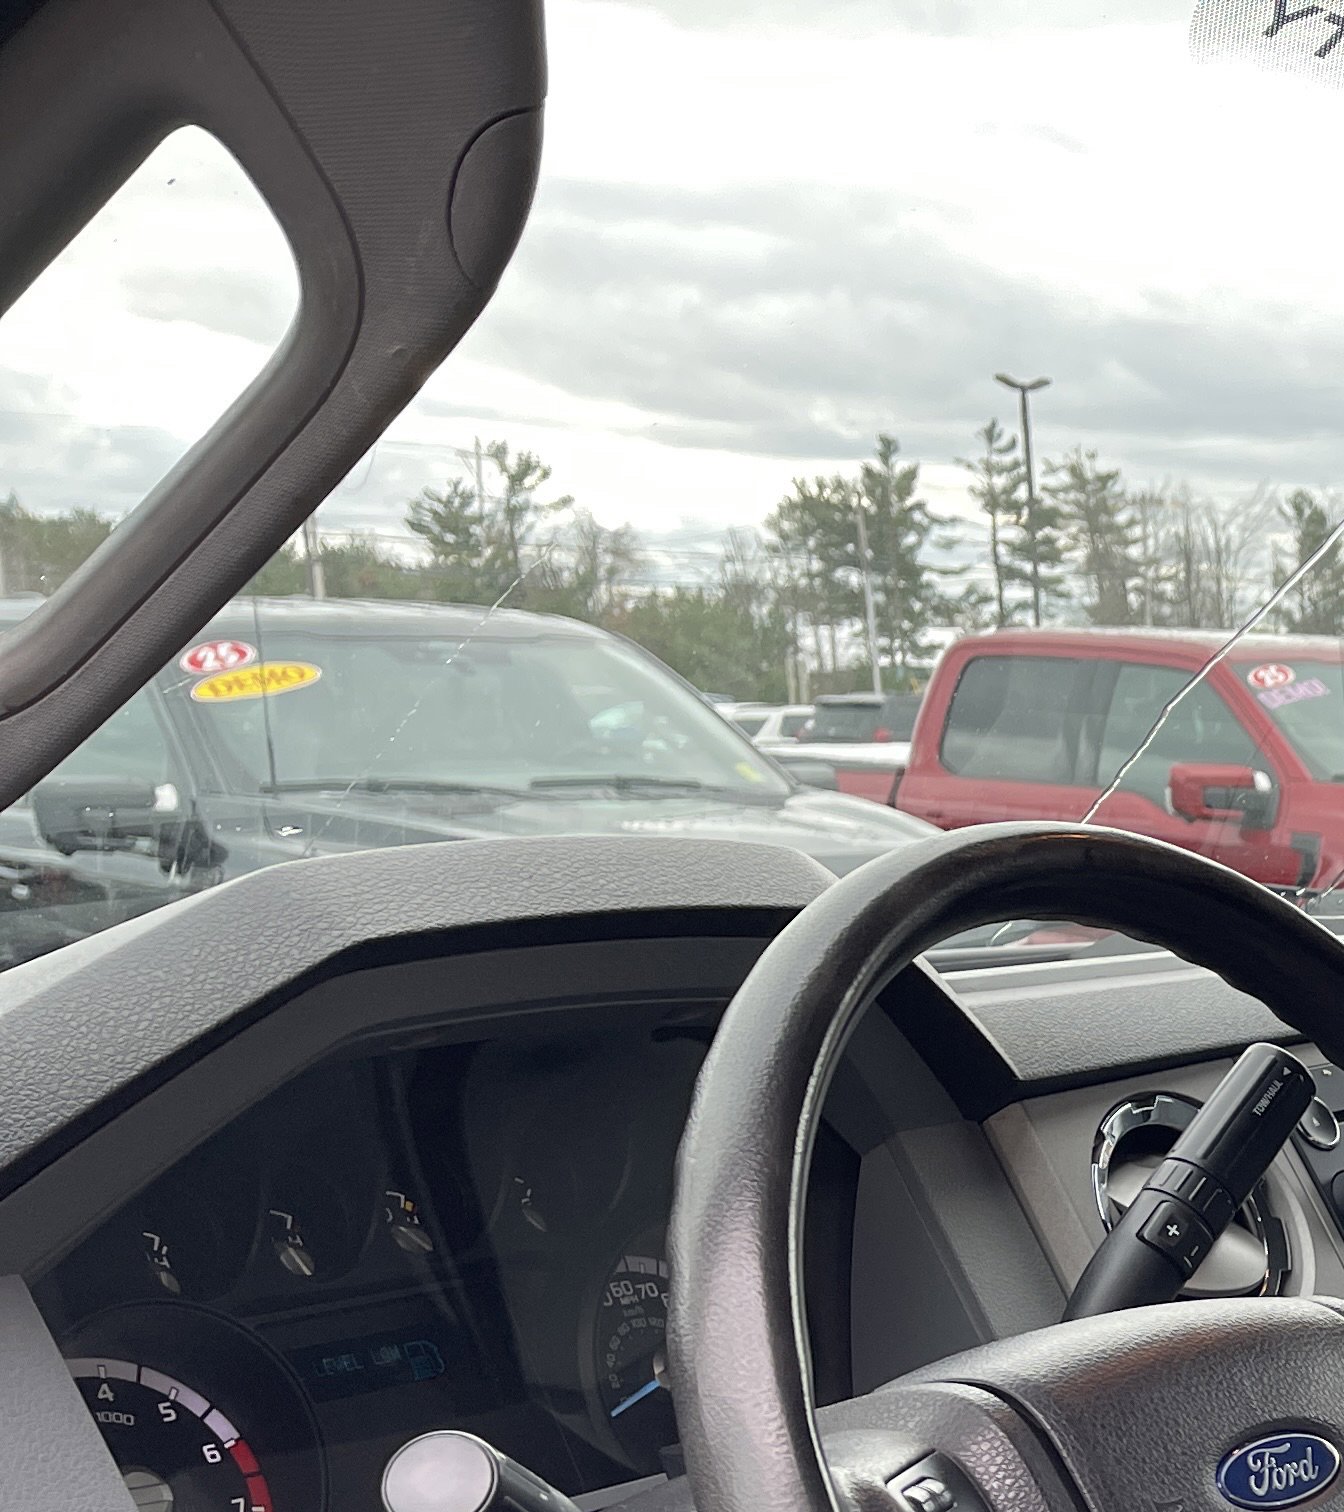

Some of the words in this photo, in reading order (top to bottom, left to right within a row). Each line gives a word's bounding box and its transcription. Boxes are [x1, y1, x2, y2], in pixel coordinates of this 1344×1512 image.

[196, 641, 240, 671] 25
[610, 1280, 634, 1298] 60
[635, 1282, 659, 1299] 70
[97, 1383, 115, 1402] 4
[157, 1402, 178, 1422] 5
[202, 1443, 222, 1463] 6
[1247, 1442, 1319, 1497] Ford
